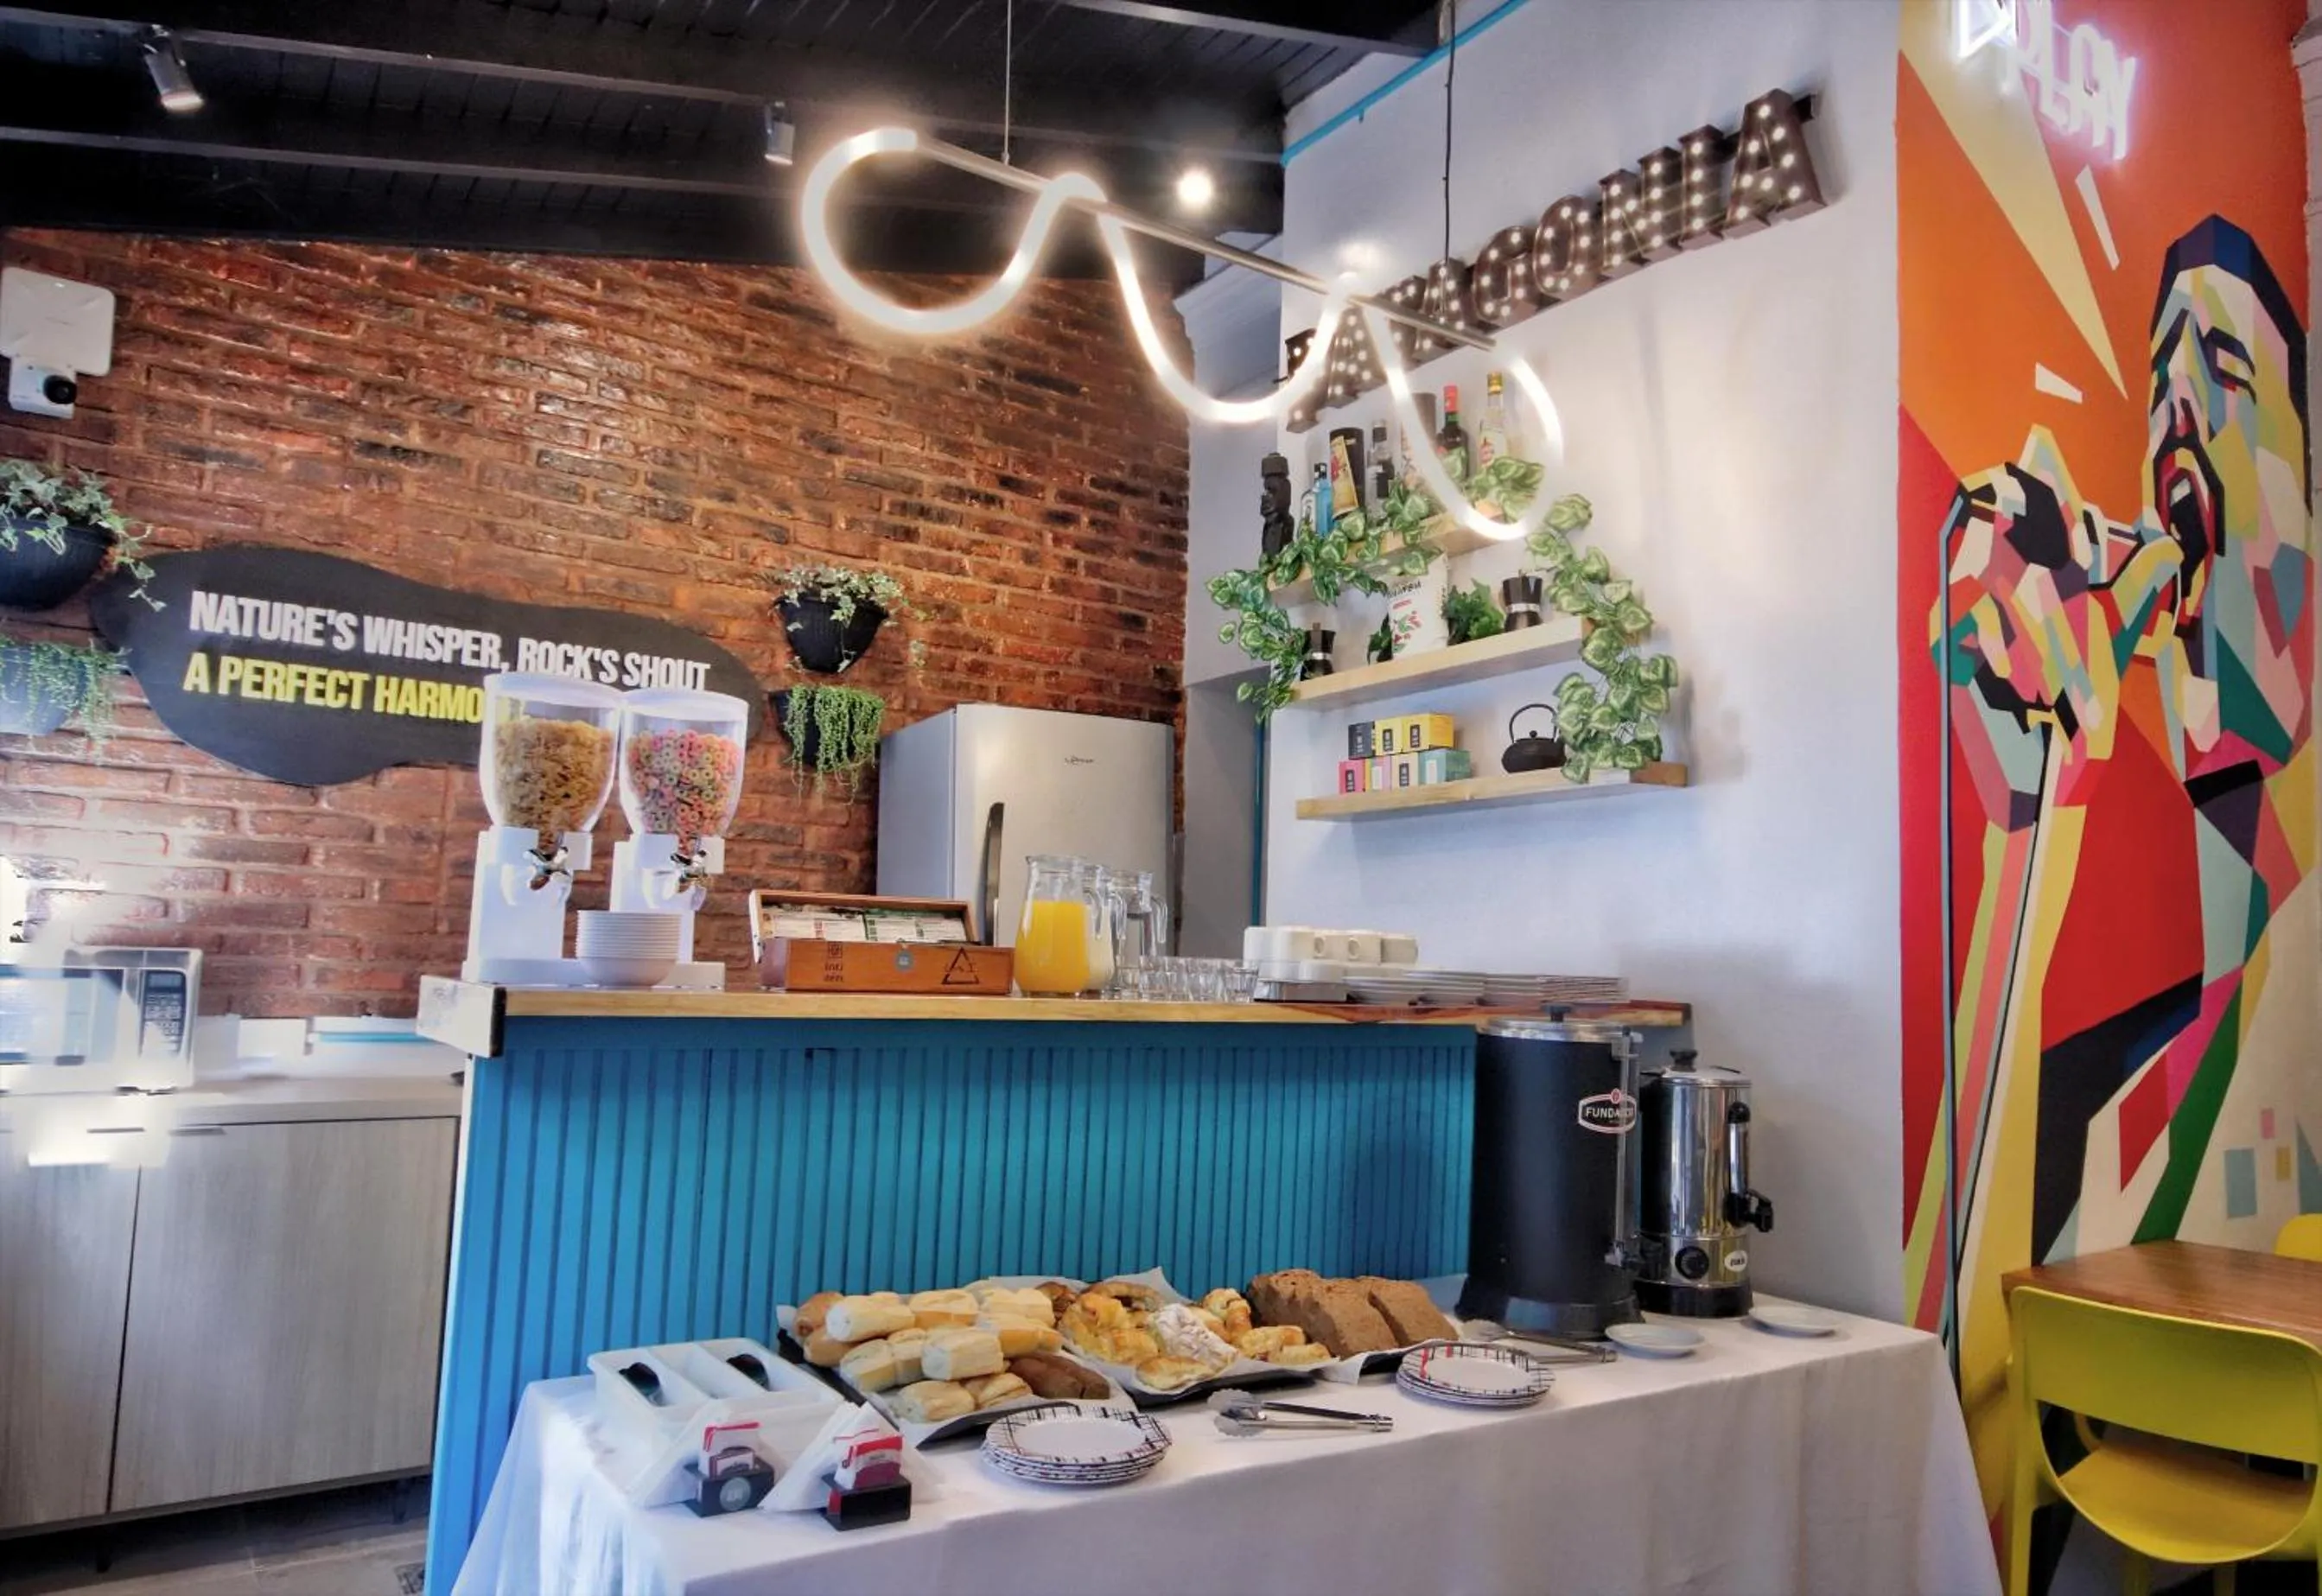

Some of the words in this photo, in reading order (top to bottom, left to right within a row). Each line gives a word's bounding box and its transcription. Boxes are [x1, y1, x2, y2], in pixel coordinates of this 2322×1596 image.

[189, 590, 358, 651] NATURE'S
[363, 615, 508, 673] WHISPER,
[518, 637, 620, 684] ROCK'S
[622, 652, 710, 690] SHOUT
[184, 653, 210, 692] A
[218, 657, 369, 710] PERFECT
[373, 676, 518, 723] HARMO
